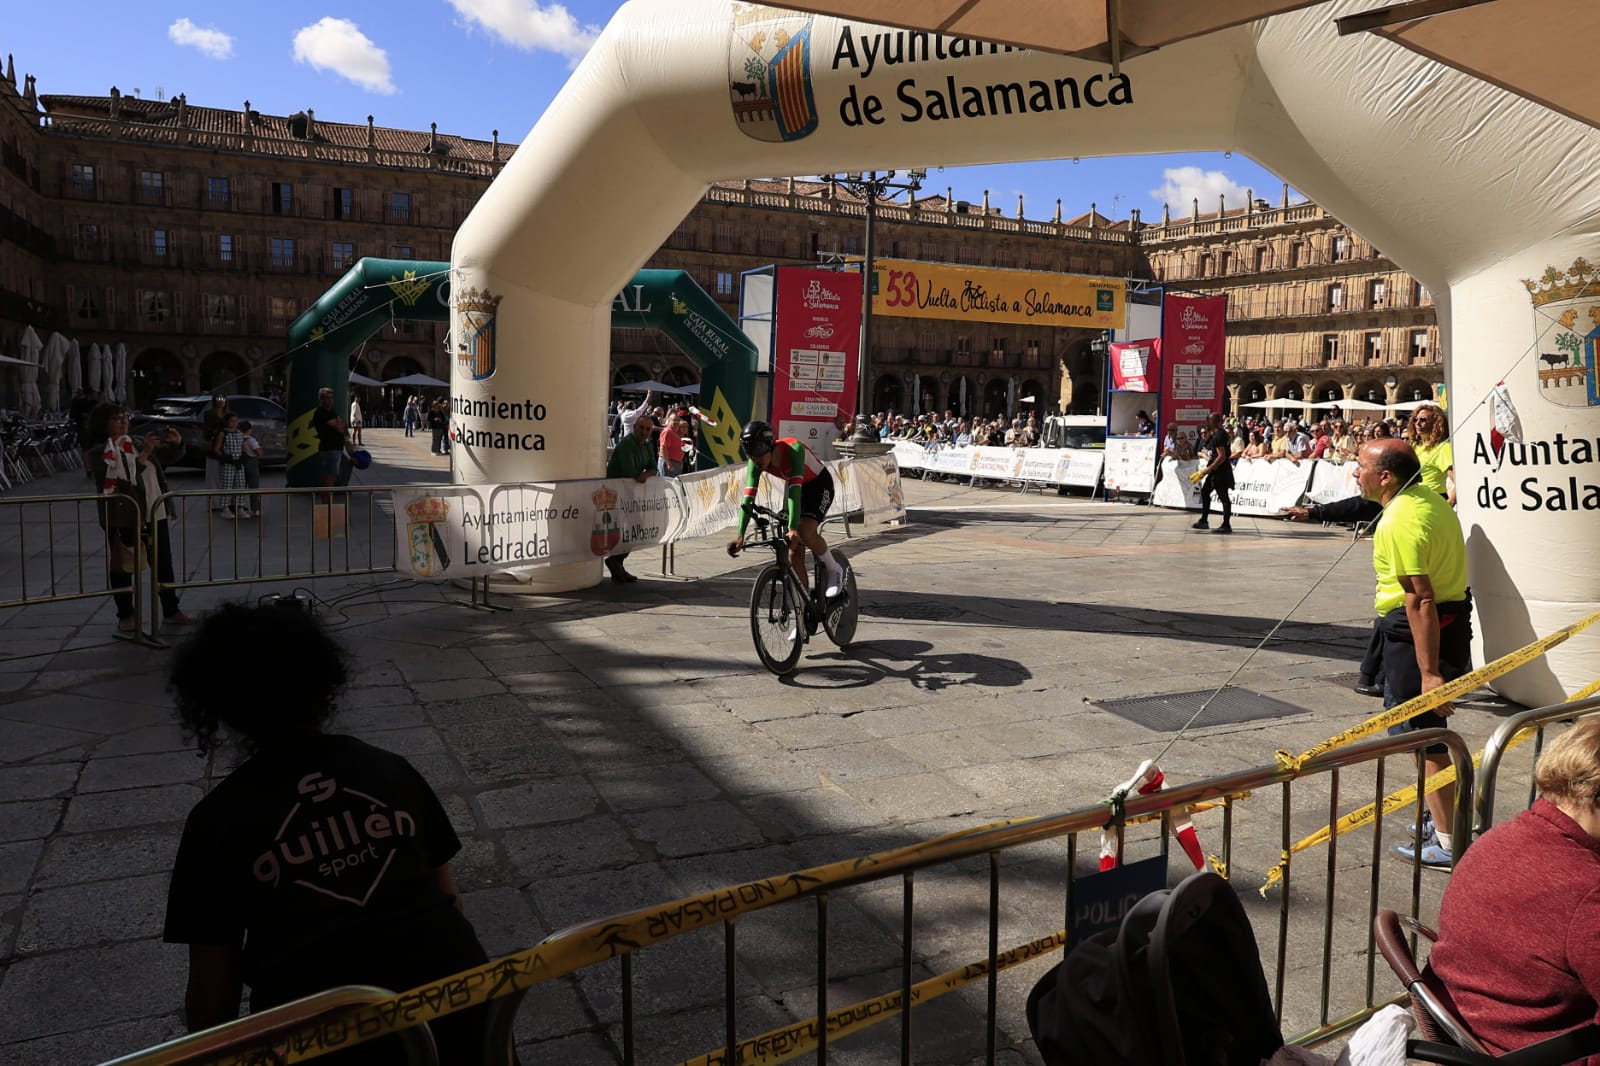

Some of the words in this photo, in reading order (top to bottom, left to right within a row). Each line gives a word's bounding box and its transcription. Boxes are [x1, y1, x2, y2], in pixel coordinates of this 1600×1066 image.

[840, 85, 886, 127] de
[897, 72, 1134, 122] Salamanca
[886, 270, 916, 307] 53
[916, 280, 959, 310] Vuelta
[1013, 301, 1021, 312] a
[1025, 288, 1093, 318] Salamanca
[706, 327, 729, 355] RURAL
[456, 423, 545, 451] alamanca
[1473, 432, 1600, 473] Ayunta
[620, 496, 670, 517] Ayuntamiento
[1477, 476, 1508, 510] de
[462, 507, 557, 530] Ayuntamiento
[562, 505, 579, 520] de
[464, 533, 550, 565] Ledrada
[319, 842, 379, 878] sport
[738, 880, 777, 905] NO
[646, 890, 738, 938] PASAR
